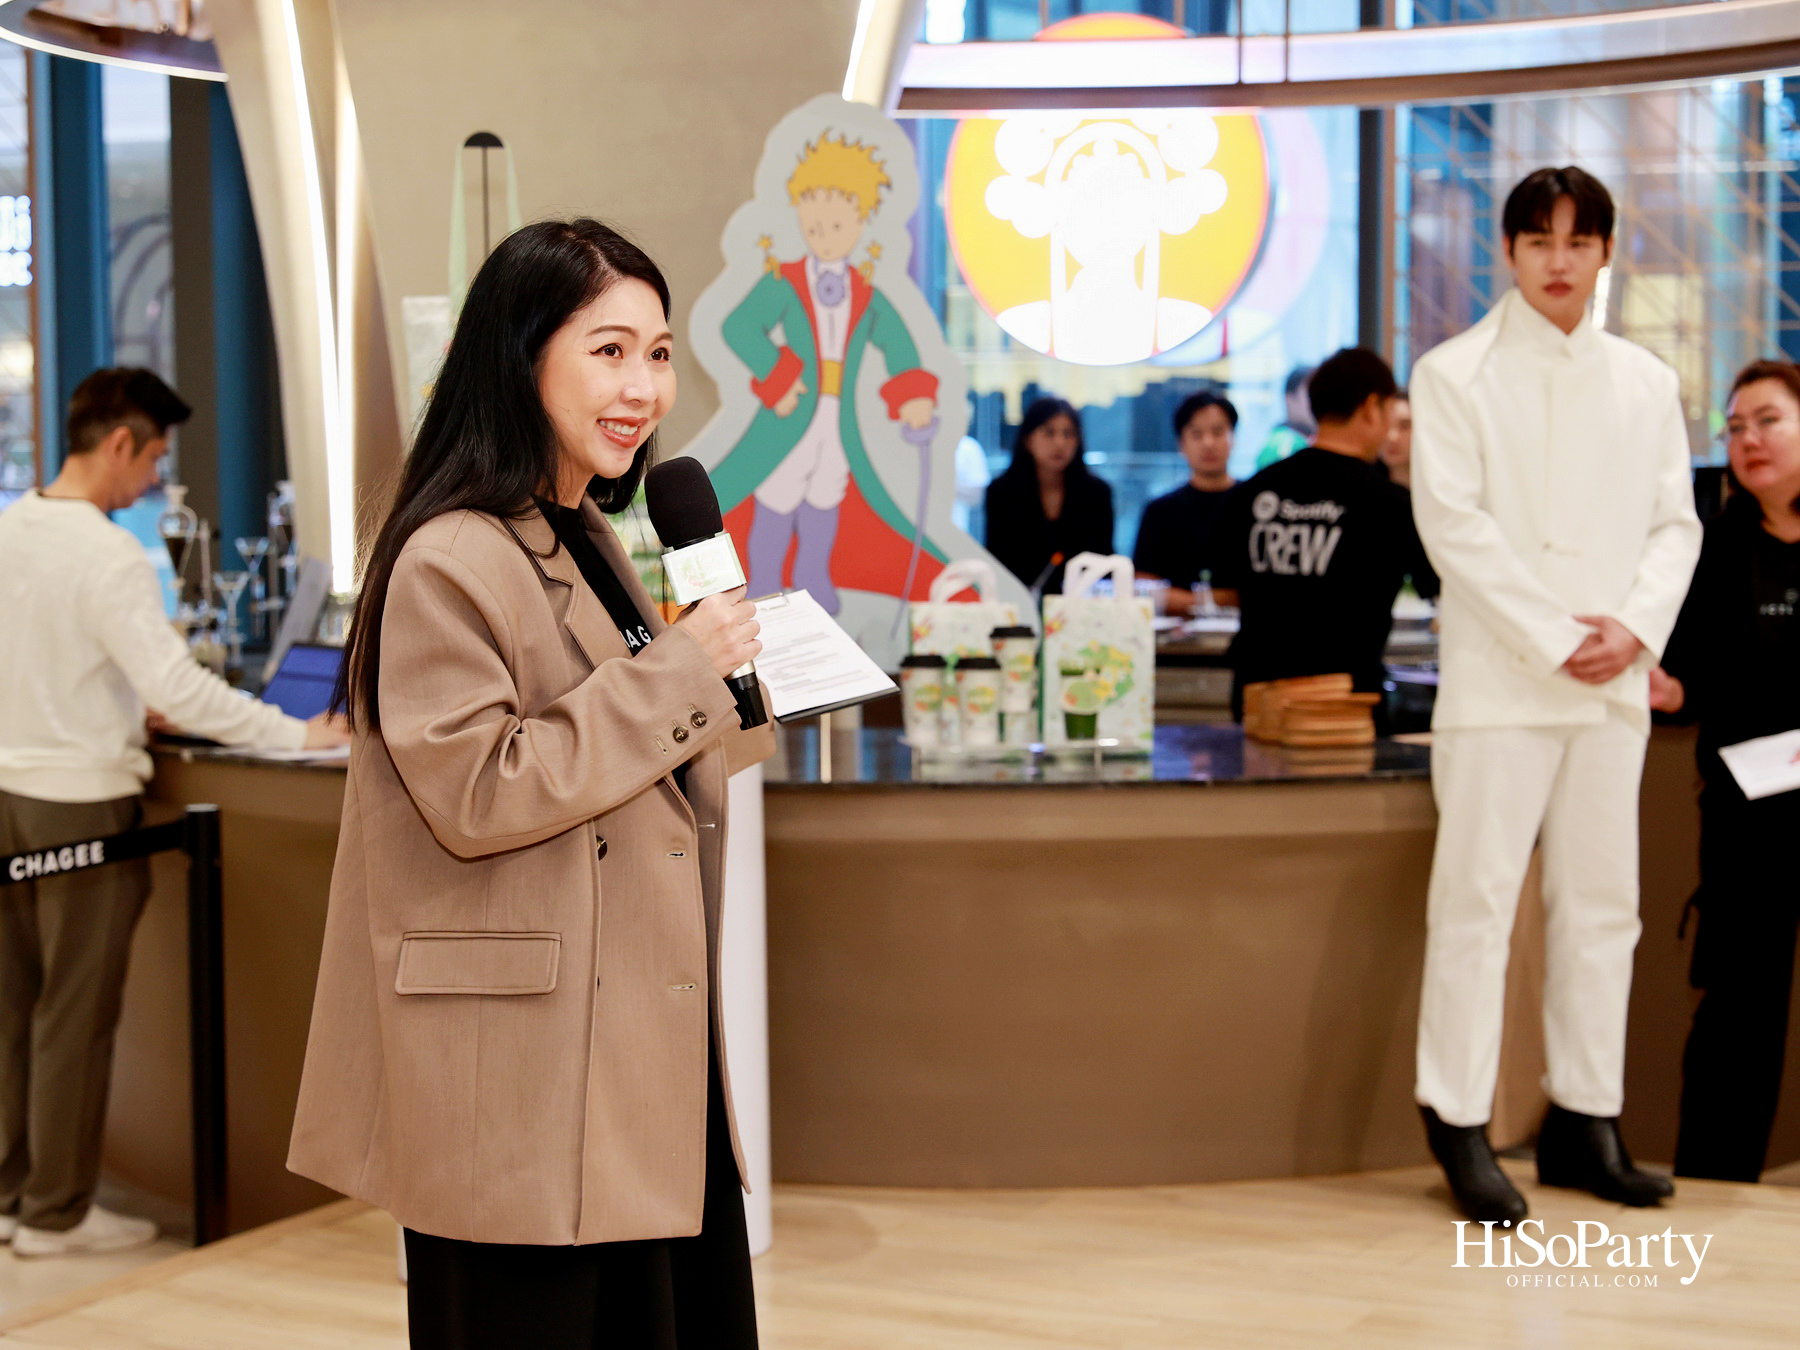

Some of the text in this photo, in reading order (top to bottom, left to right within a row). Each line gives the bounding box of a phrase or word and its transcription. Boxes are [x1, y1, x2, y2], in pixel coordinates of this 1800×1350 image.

[1280, 499, 1345, 523] Spotify
[1248, 521, 1342, 576] CREW
[619, 625, 652, 648] AG
[9, 840, 105, 881] CHAGEE
